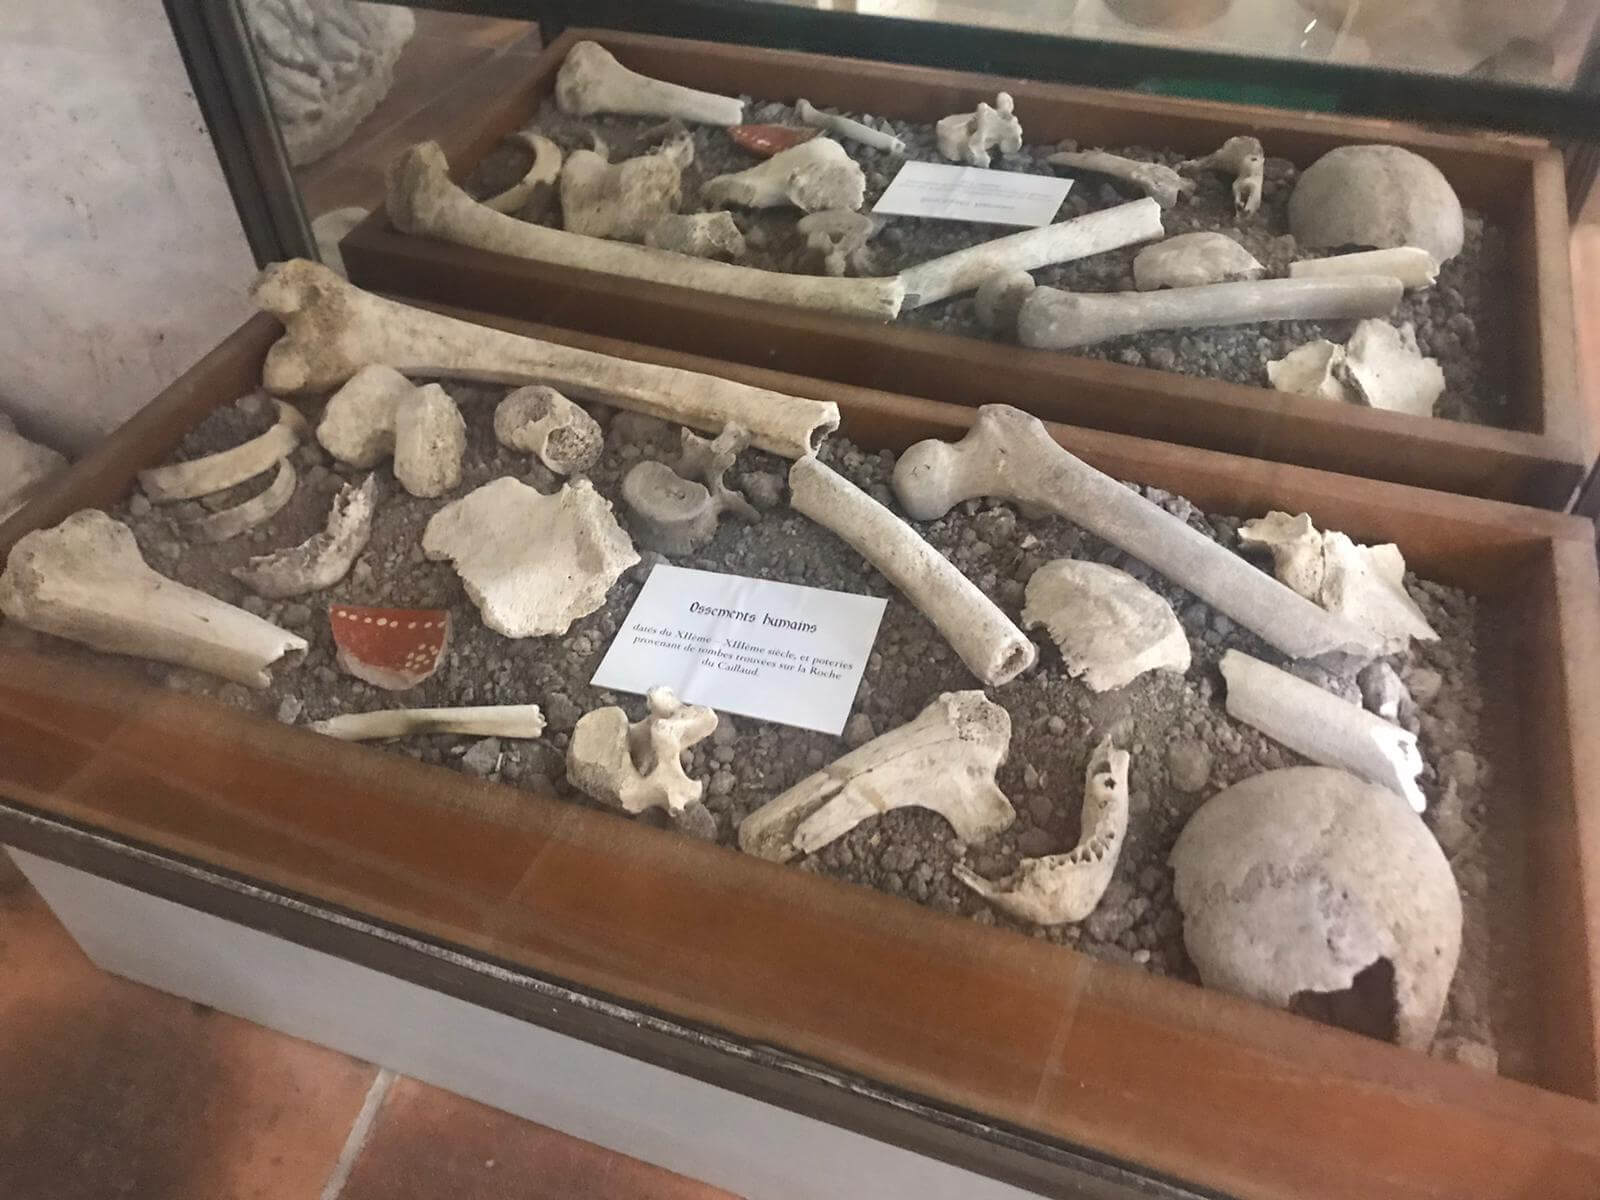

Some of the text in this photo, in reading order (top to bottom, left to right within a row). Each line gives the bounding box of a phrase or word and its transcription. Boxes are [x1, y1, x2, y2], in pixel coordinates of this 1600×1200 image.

[689, 601, 817, 633] Ossements humains
[633, 623, 657, 634] datés
[659, 627, 672, 637] du
[767, 647, 797, 660] siècle,
[800, 654, 810, 662] et
[811, 656, 853, 670] poteries
[633, 635, 681, 650] provenant
[683, 643, 695, 652] de
[697, 646, 733, 659] tombes
[779, 662, 794, 671] sur
[797, 664, 806, 673] la
[809, 666, 843, 680] Roche
[701, 658, 715, 668] du
